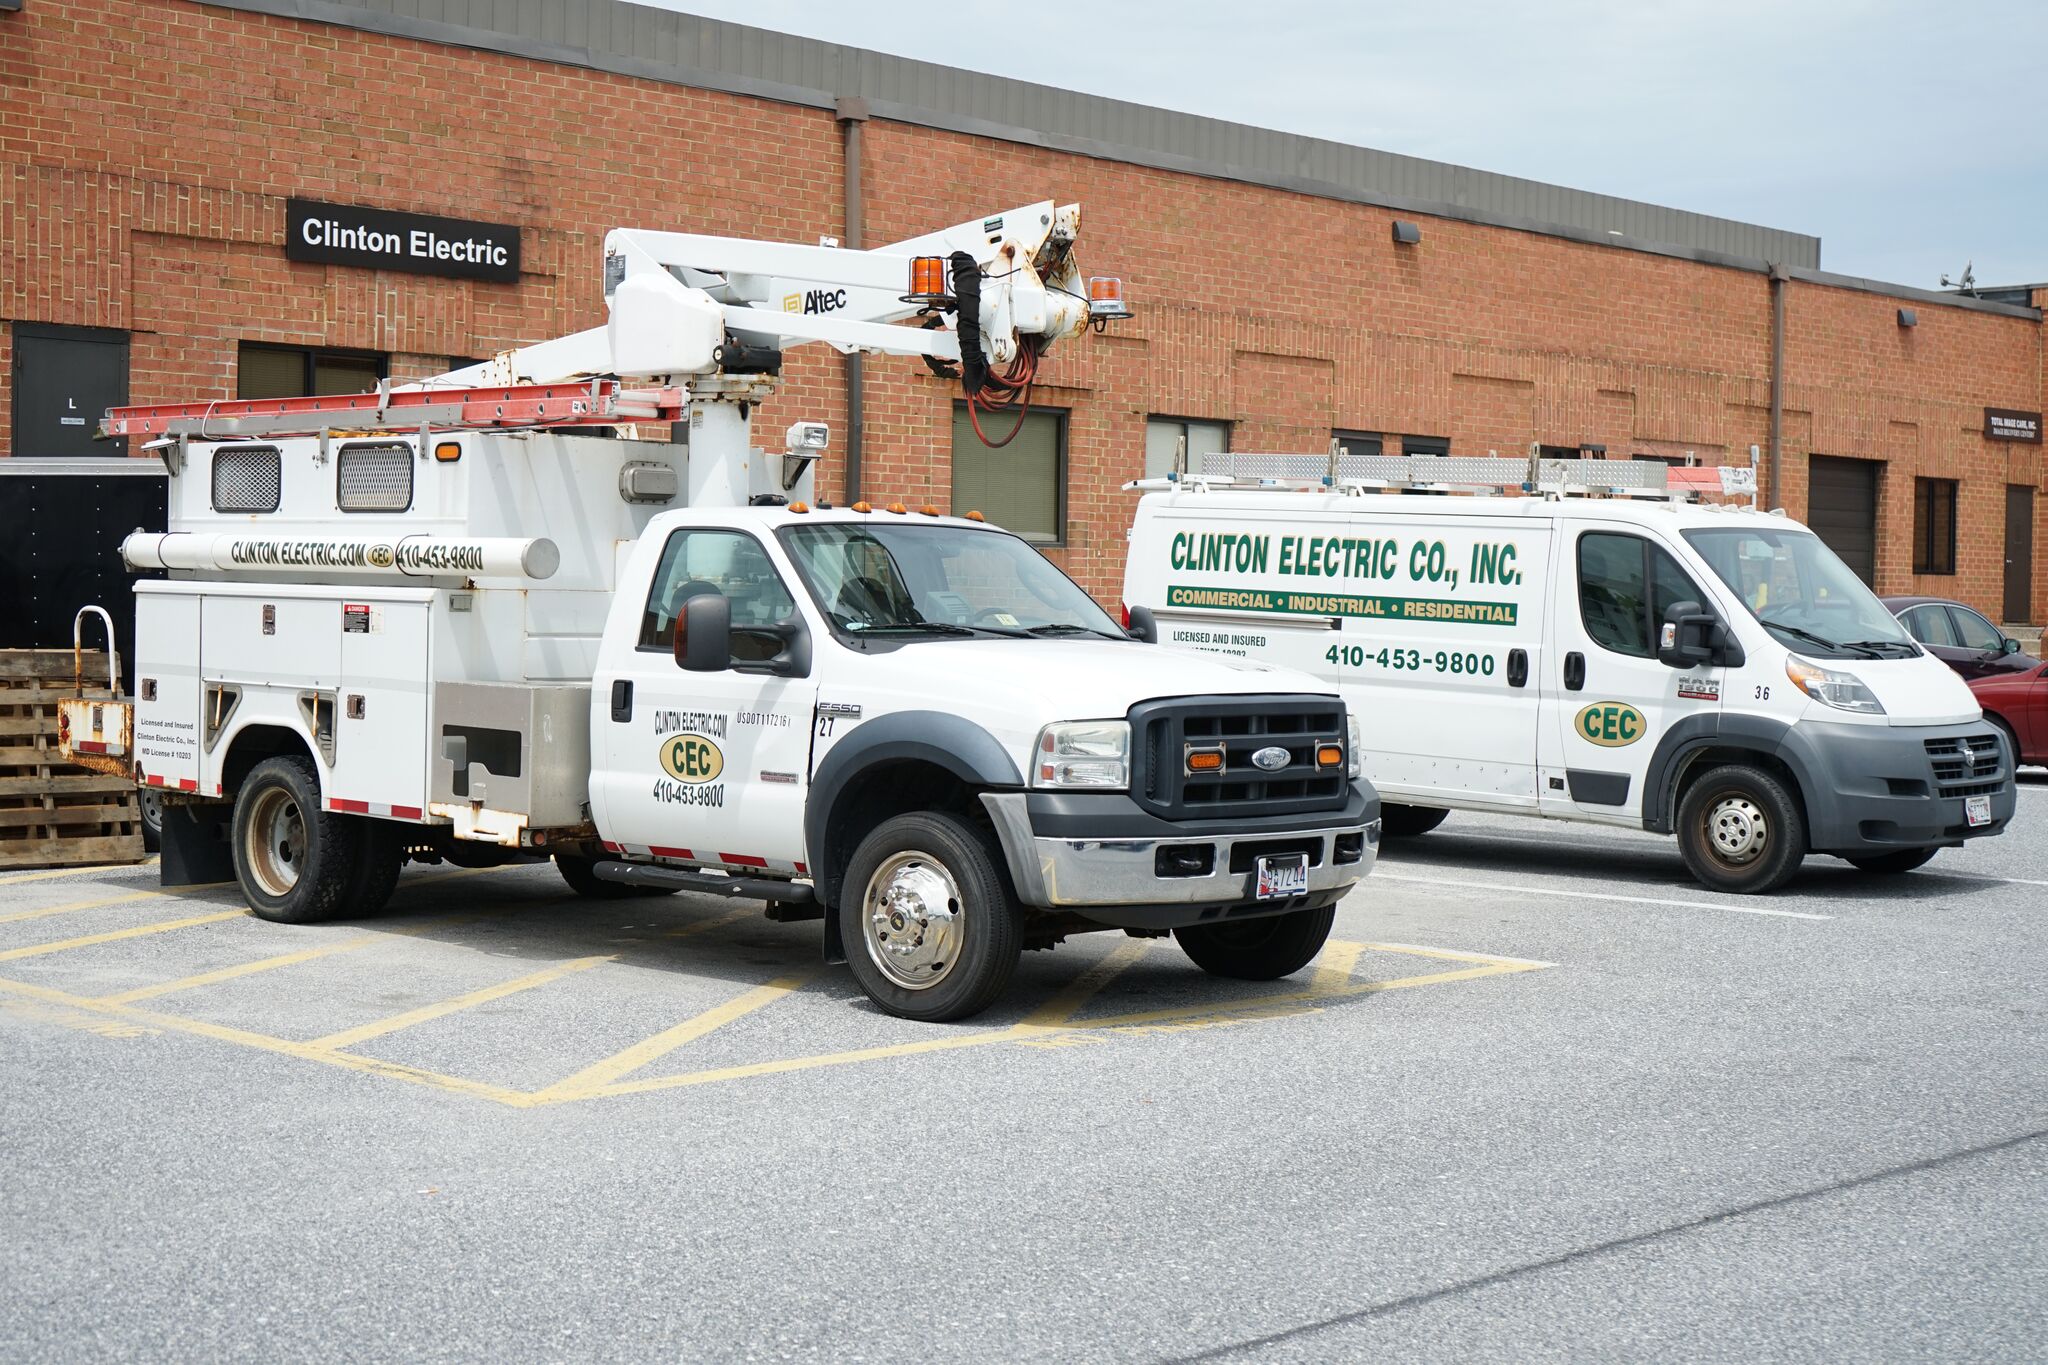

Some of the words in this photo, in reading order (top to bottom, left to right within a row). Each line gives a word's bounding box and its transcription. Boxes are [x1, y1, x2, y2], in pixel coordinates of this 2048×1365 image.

[302, 218, 401, 254] Clinton
[410, 230, 508, 266] Electric
[804, 289, 847, 315] Altec
[69, 397, 77, 409] L
[231, 541, 280, 564] CLINTON
[281, 543, 367, 567] ELECTRIC.COM
[371, 547, 389, 564] CEC
[396, 545, 484, 570] 410-453-9800
[1171, 531, 1271, 574] CLINTON
[1278, 536, 1399, 580] ELECTRIC
[1409, 539, 1459, 592] CO.,
[1470, 543, 1523, 586] INC.
[1172, 589, 1274, 609] COMMERCIAL
[1288, 595, 1385, 616] INDUSTRIAL
[1403, 602, 1515, 623] RESIDENTIAL
[1173, 630, 1210, 643] LICENSED
[1212, 633, 1229, 645] AND
[1231, 634, 1266, 647] INSURED
[1325, 645, 1495, 676] 410-453-9800
[1754, 685, 1770, 701] 36
[136, 732, 155, 741] Clinton
[155, 734, 176, 744] Electric
[141, 717, 164, 727] Licensed
[164, 720, 174, 728] and
[174, 721, 194, 730] Insured
[654, 710, 681, 735] CLINTON
[682, 711, 728, 740] ELECTRIC.COM
[819, 717, 835, 737] 27
[1583, 707, 1638, 740] CEC
[672, 741, 711, 776] CEC
[653, 779, 725, 808] 410-453-9800
